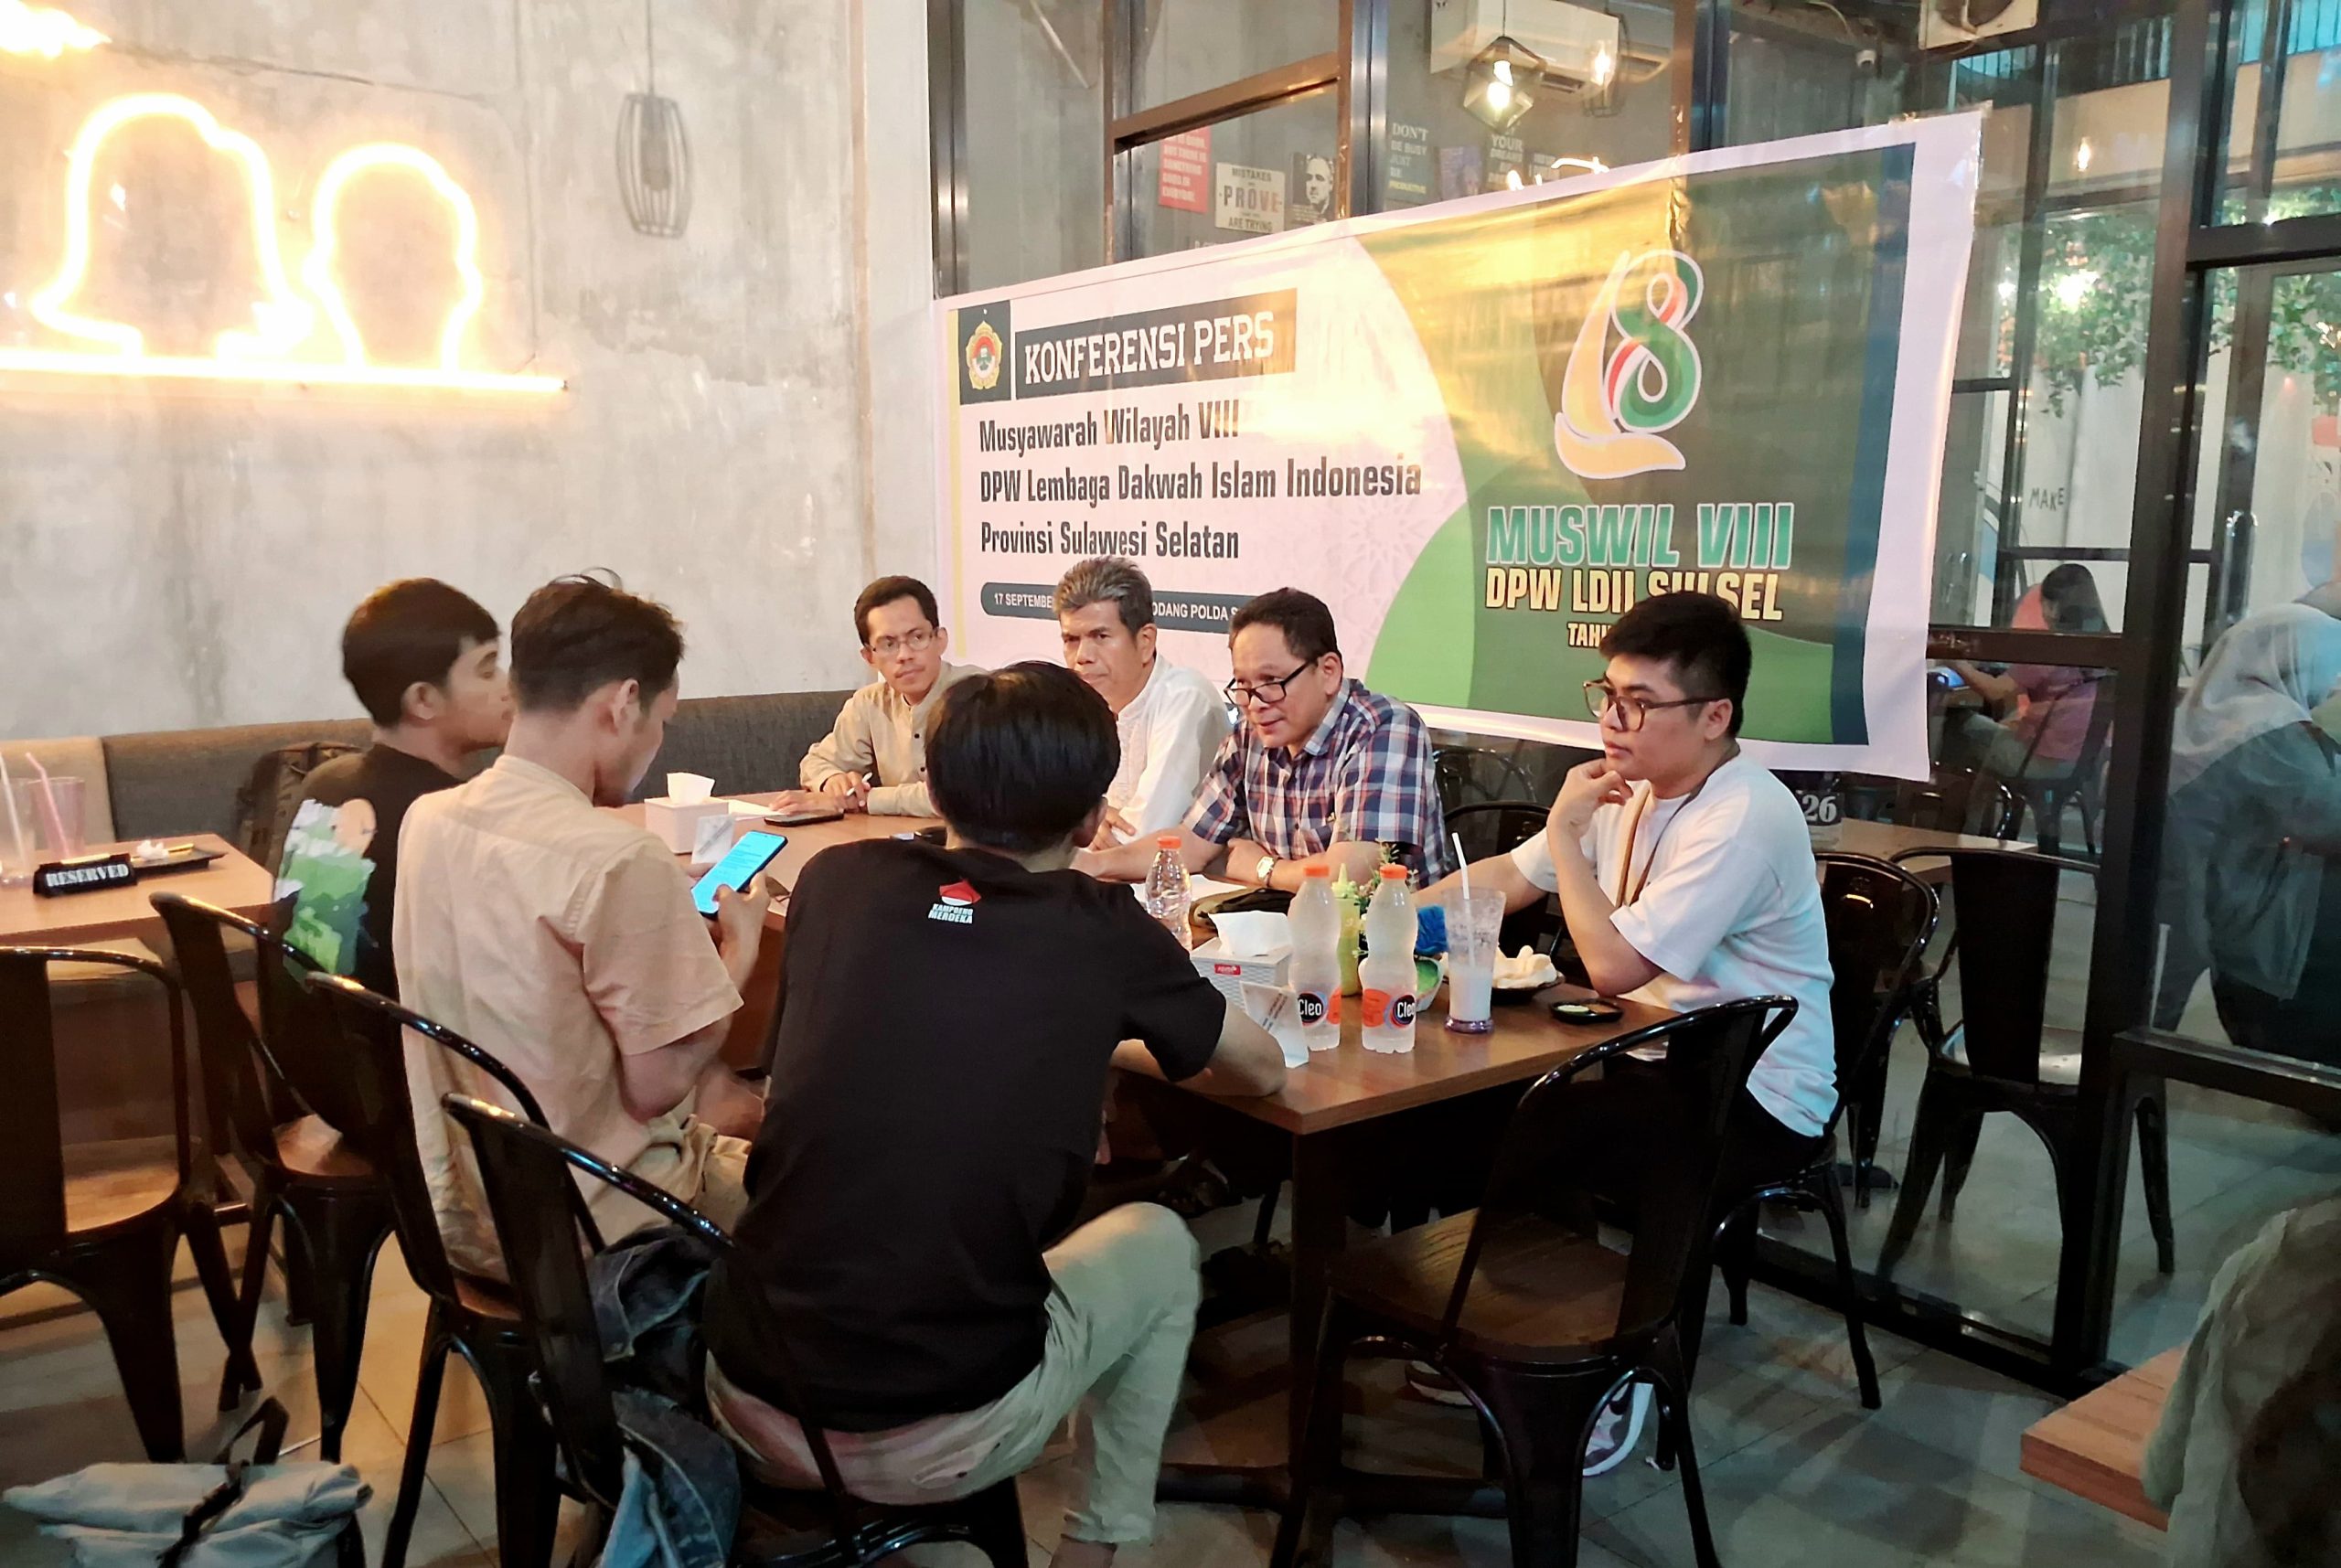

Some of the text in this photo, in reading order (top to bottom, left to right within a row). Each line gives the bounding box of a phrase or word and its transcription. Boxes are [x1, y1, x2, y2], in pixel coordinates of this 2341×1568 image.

[1393, 123, 1428, 142] DON'T
[1232, 167, 1272, 182] MISTAKES
[1224, 185, 1280, 212] PROVE
[1228, 217, 1273, 232] ARE TRYING
[1024, 311, 1275, 385] KONFERENSI PERS
[979, 399, 1240, 458] Musyawarah Wilayah VIII
[980, 453, 1422, 508] DPW Lembaga Dakwah Islam Indonesia
[2029, 487, 2064, 511] MAKE
[981, 520, 1239, 559] Provinsi Sulawesi Selatan
[1485, 503, 1795, 571] MUSWIL VIII
[1485, 567, 1562, 611] DPW
[1572, 569, 1636, 614] LDII
[994, 593, 1003, 605] 17
[1005, 593, 1053, 609] SEPTEMBE
[1151, 601, 1188, 619] ODANG
[1190, 604, 1229, 622] POLDA
[1801, 795, 1837, 823] 26
[46, 864, 129, 887] RESERVED
[928, 909, 973, 924] MERDEKA
[1299, 999, 1322, 1017] Cleo
